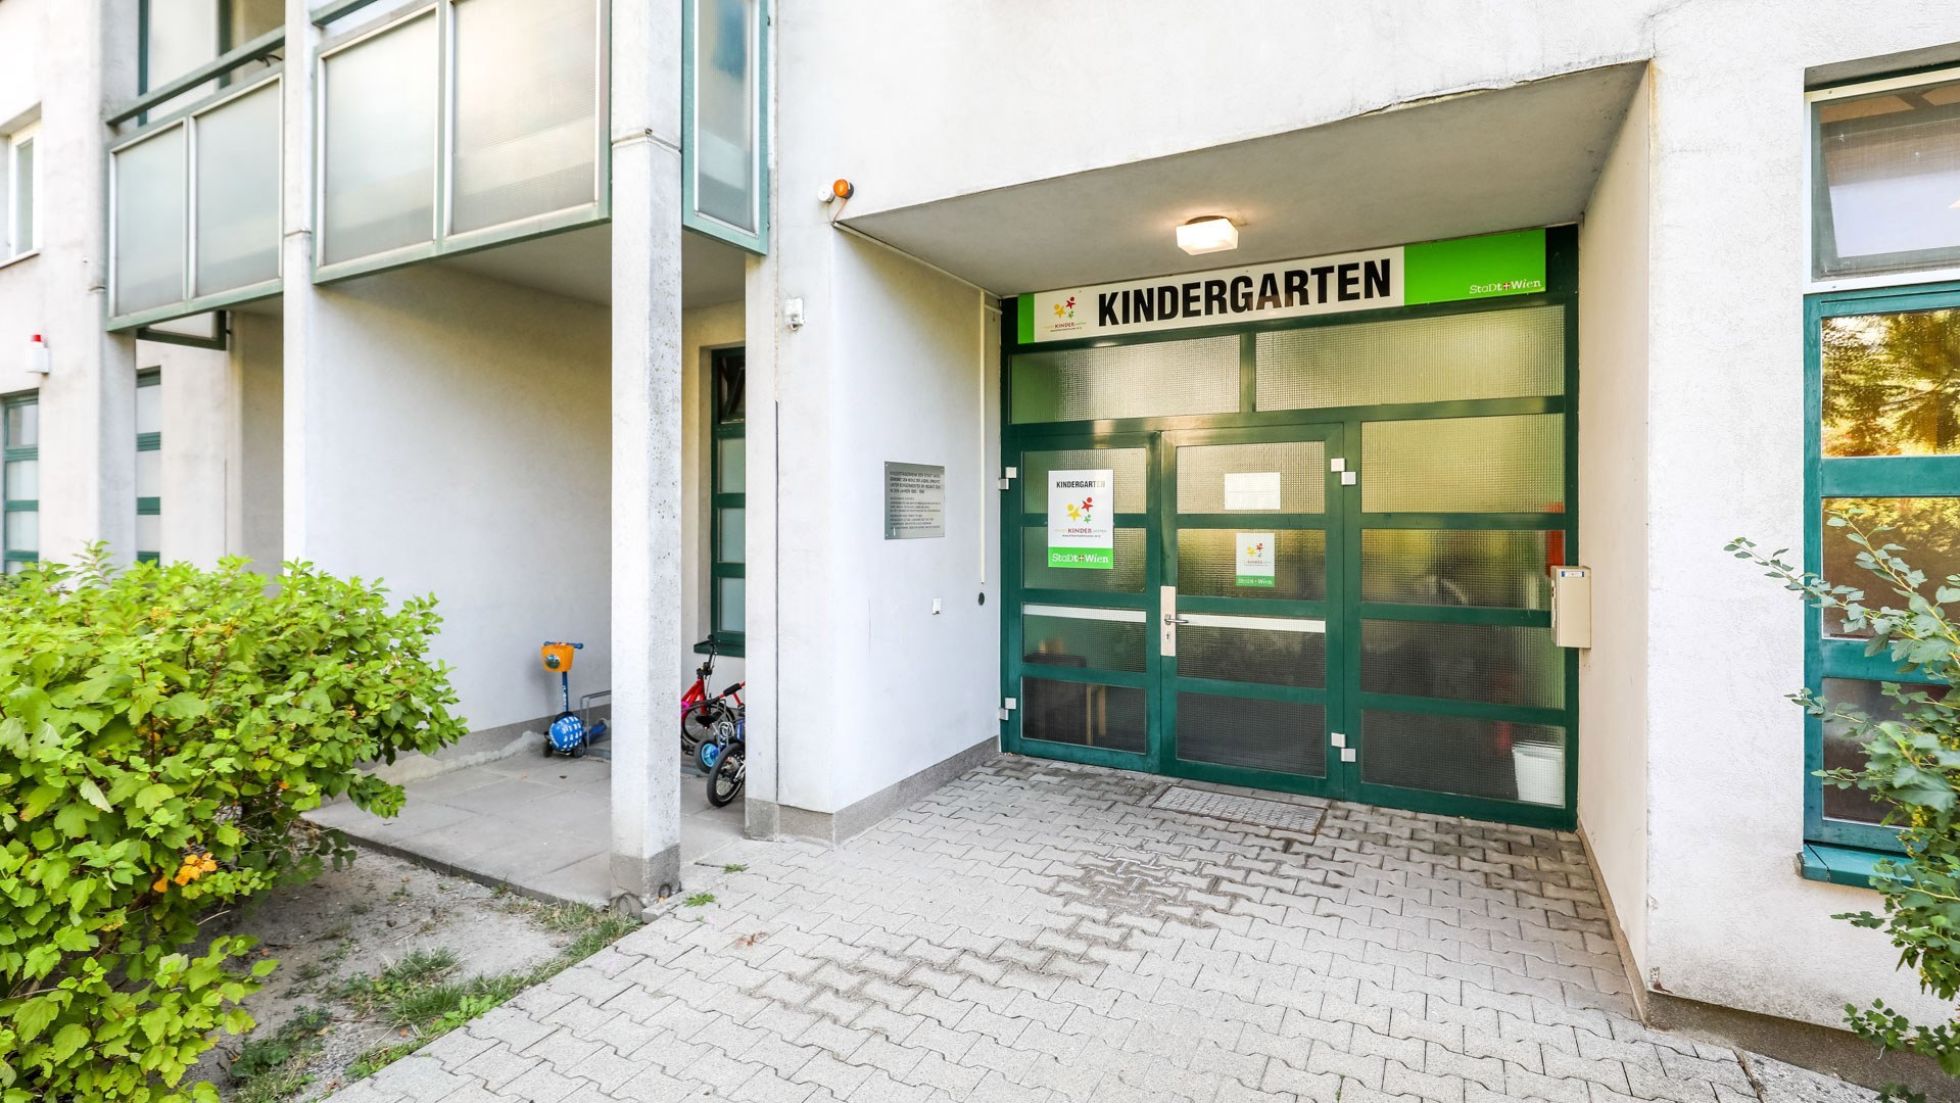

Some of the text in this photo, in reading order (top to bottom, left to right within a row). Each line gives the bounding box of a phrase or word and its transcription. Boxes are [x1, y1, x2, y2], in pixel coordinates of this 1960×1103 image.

[1510, 278, 1541, 290] Wien
[1098, 258, 1391, 327] KINDERGARTEN
[1056, 480, 1105, 489] KINDERGARTEN
[1084, 553, 1109, 564] Wien
